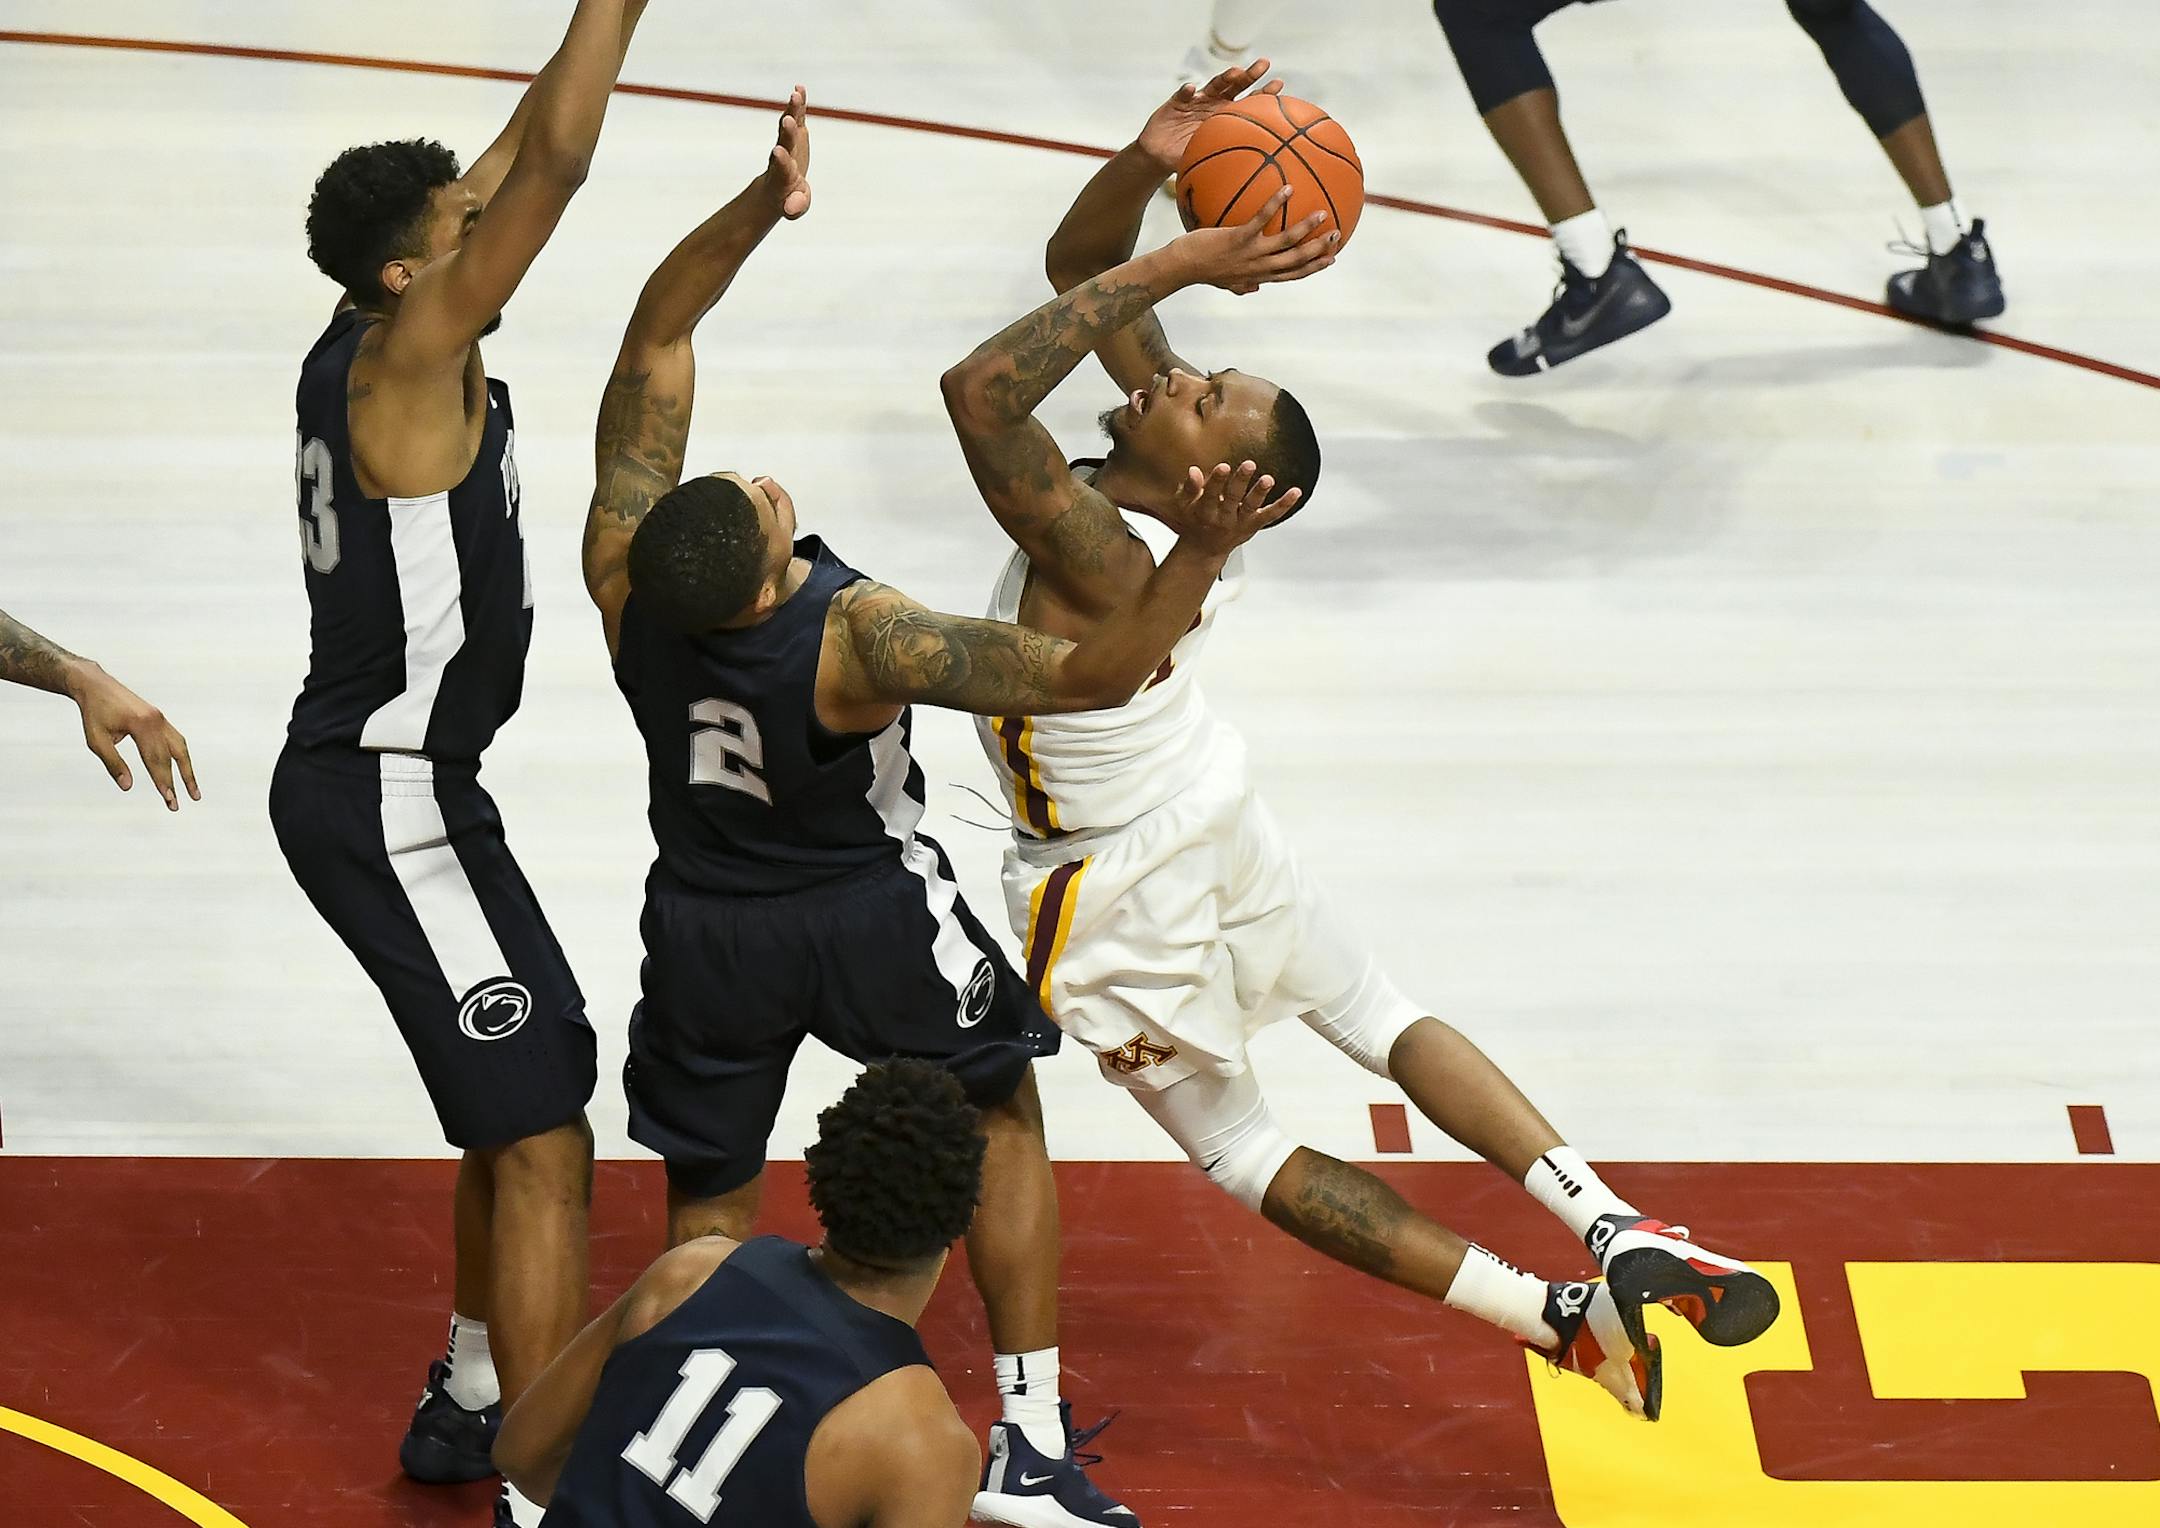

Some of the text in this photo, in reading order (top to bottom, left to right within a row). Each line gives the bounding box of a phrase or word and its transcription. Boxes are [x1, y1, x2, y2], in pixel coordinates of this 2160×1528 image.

[295, 429, 341, 574] 3
[688, 697, 773, 806] 2
[620, 1347, 783, 1524] 11
